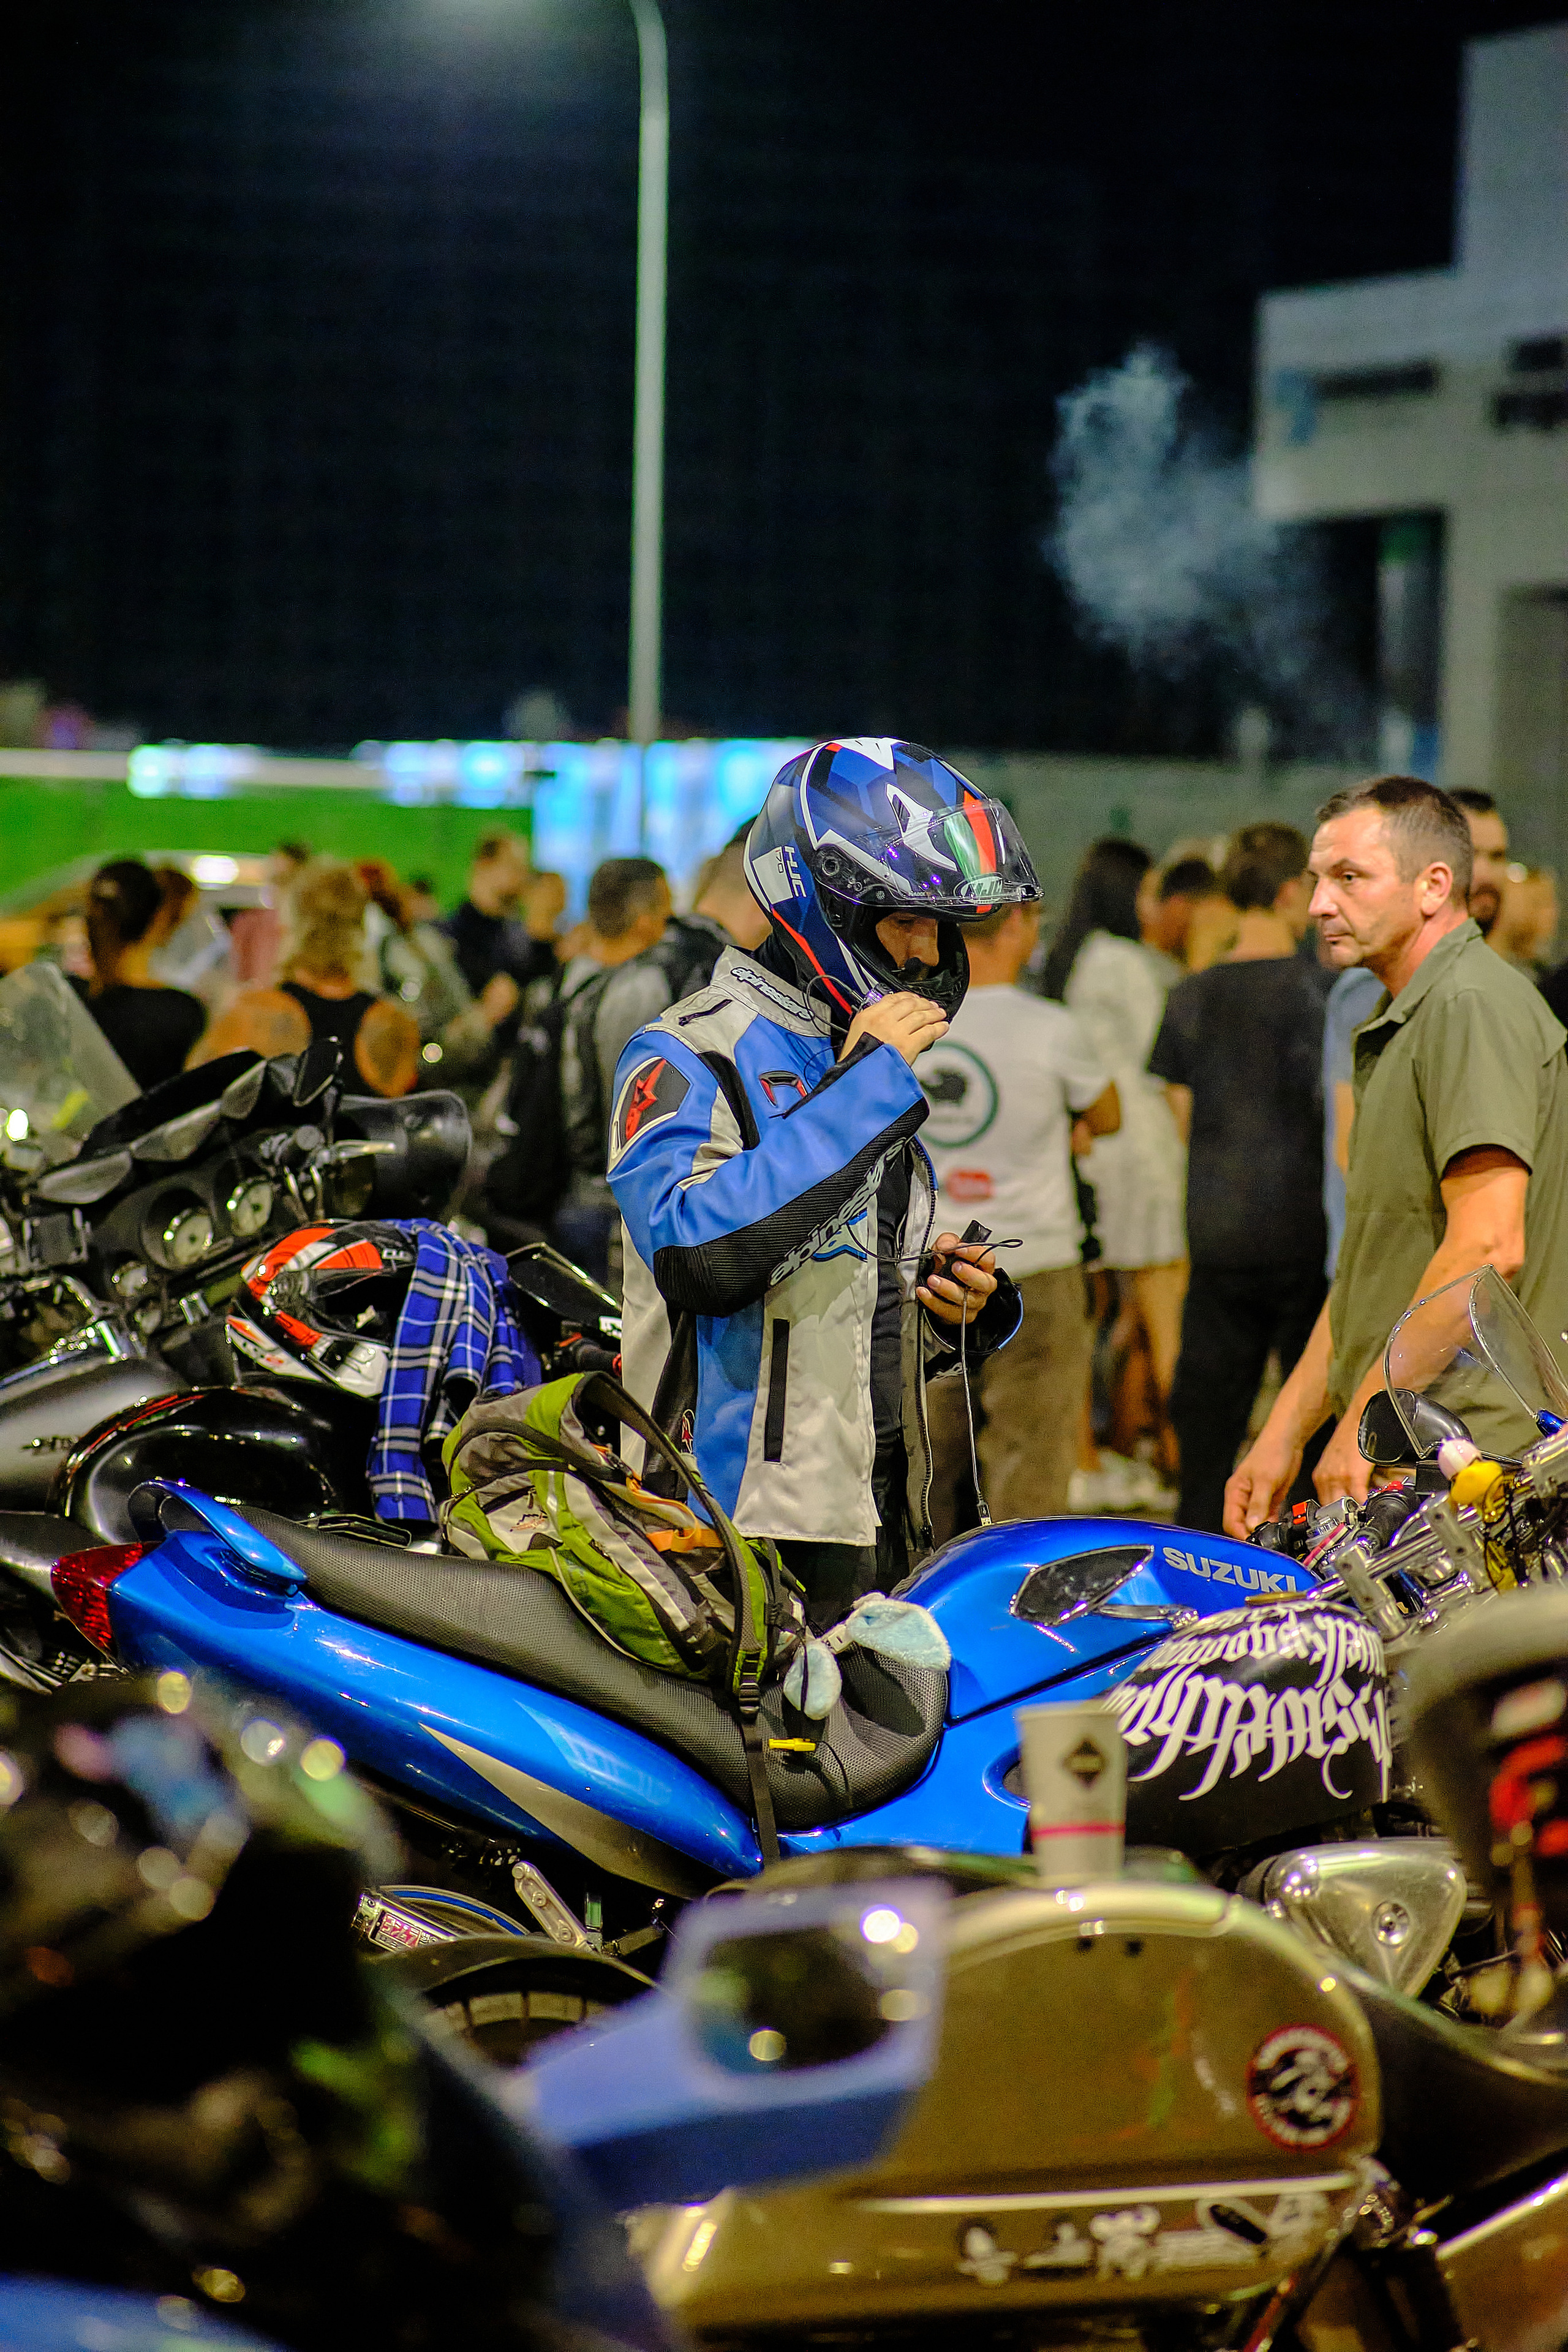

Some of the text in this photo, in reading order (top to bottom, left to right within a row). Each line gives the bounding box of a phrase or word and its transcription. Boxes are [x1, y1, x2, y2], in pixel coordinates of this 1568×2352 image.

[784, 846, 807, 897] HJC
[731, 967, 815, 1021] alpinestars
[1163, 1547, 1297, 1593] SUZUKI
